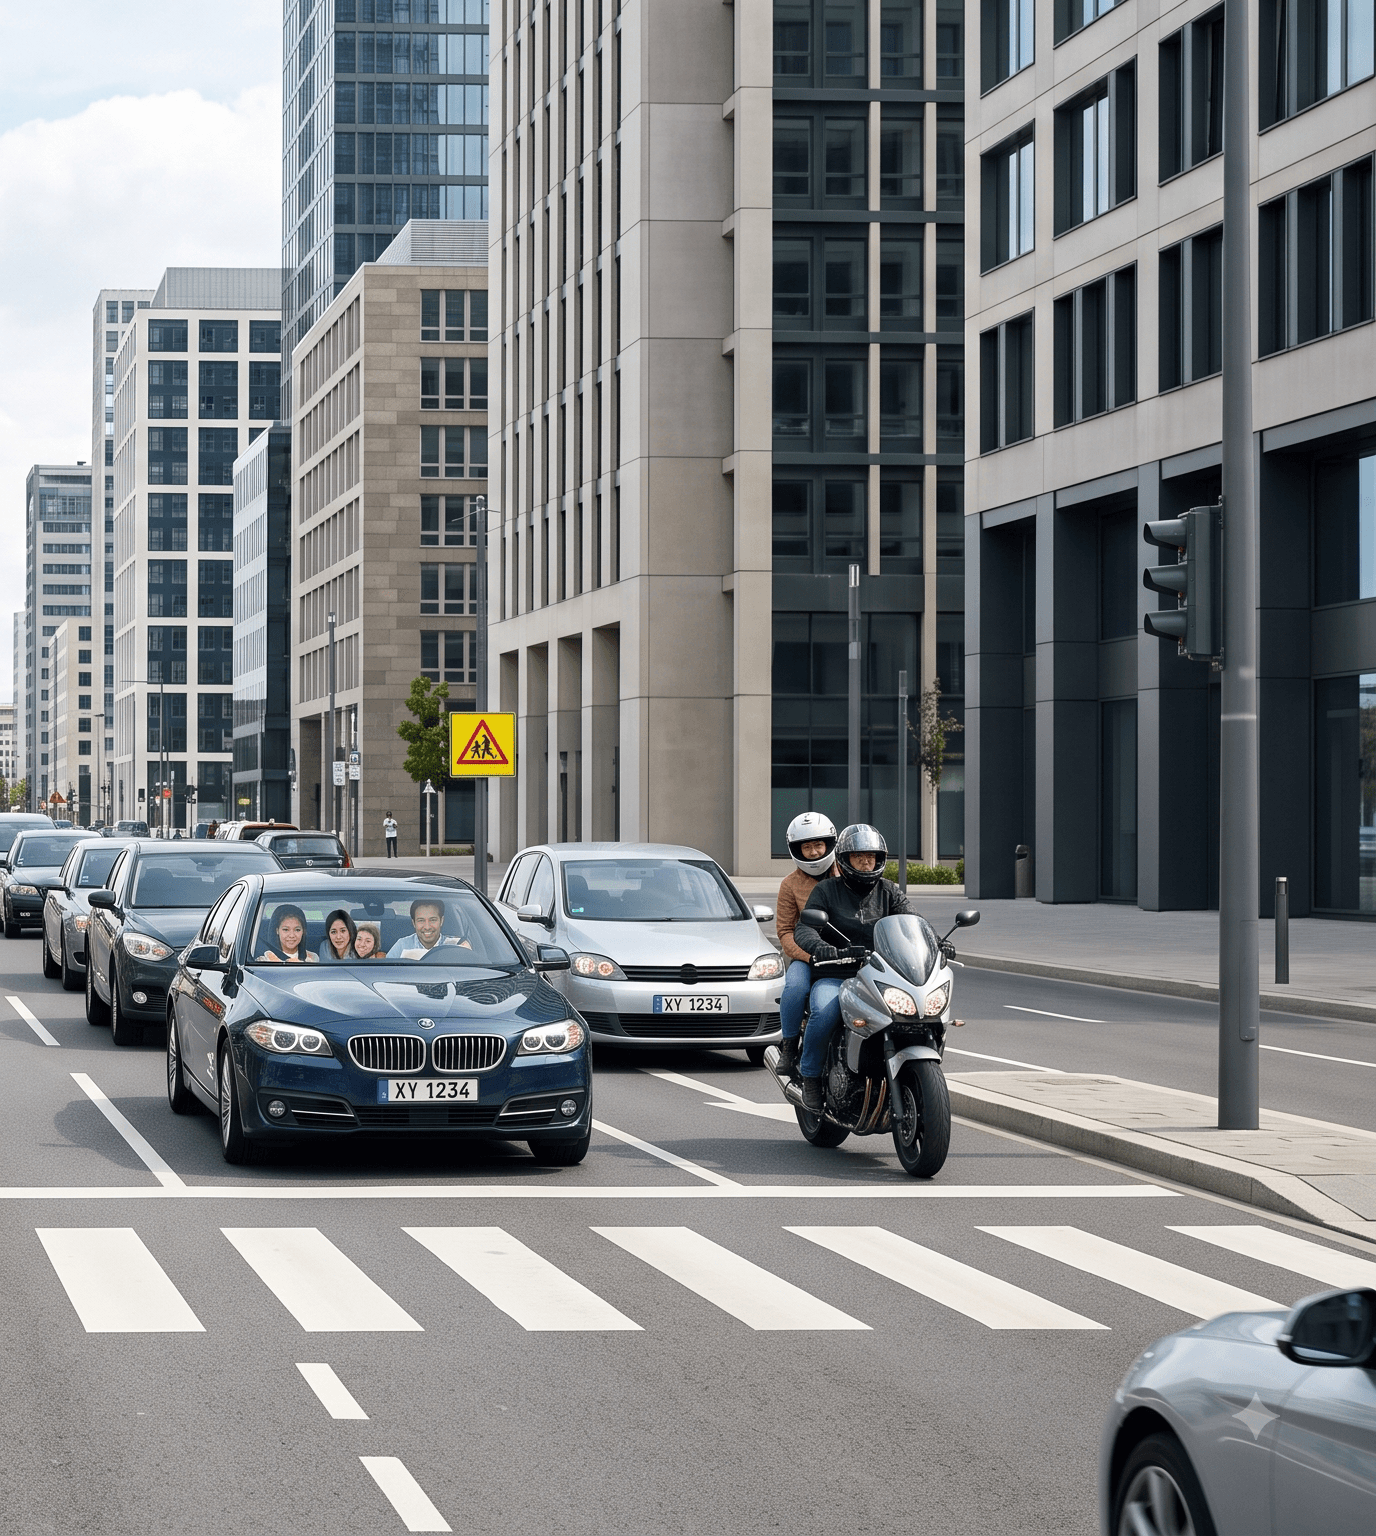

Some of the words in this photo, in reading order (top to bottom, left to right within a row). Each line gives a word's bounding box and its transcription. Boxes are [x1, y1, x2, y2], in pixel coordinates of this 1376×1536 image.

[664, 998, 683, 1011] XY
[689, 998, 723, 1011] 1234
[395, 1082, 418, 1099] XY
[426, 1081, 470, 1099] 1234
